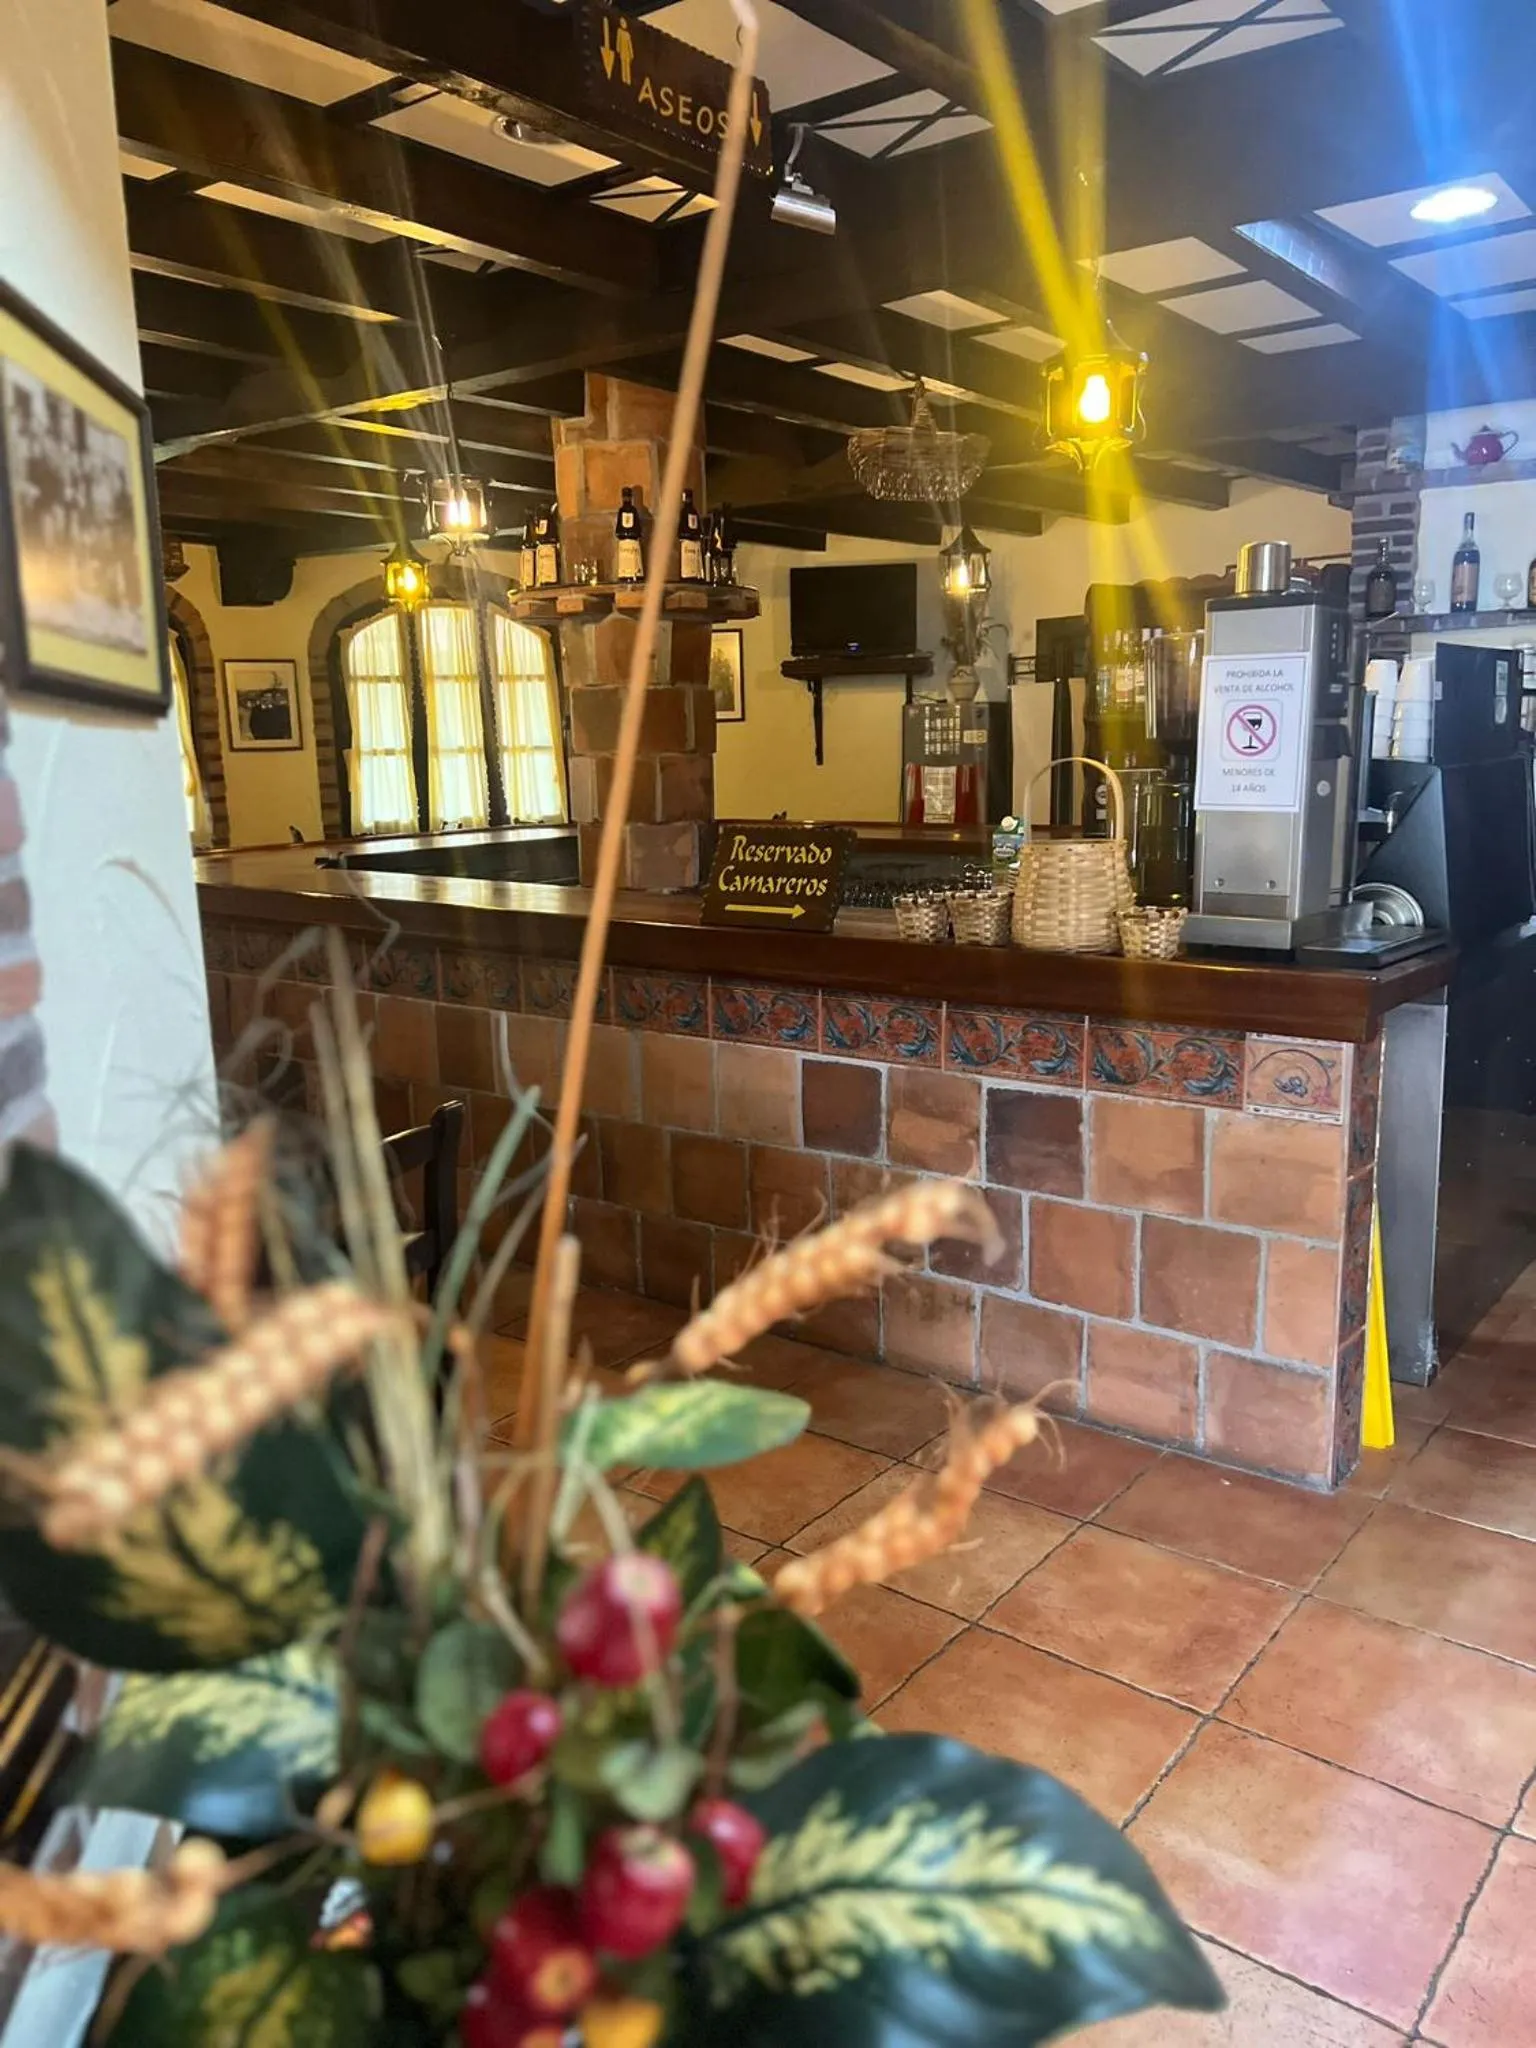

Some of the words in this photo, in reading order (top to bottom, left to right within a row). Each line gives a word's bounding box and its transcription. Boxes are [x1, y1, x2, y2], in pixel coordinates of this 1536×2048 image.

[638, 76, 731, 139] ASEOS
[1273, 668, 1284, 678] LA
[1213, 685, 1240, 694] VENTA
[1242, 684, 1253, 693] DE
[1222, 767, 1262, 776] MENORES
[1264, 768, 1275, 776] DE
[730, 834, 832, 864] Reservado
[718, 865, 828, 896] Camareros
